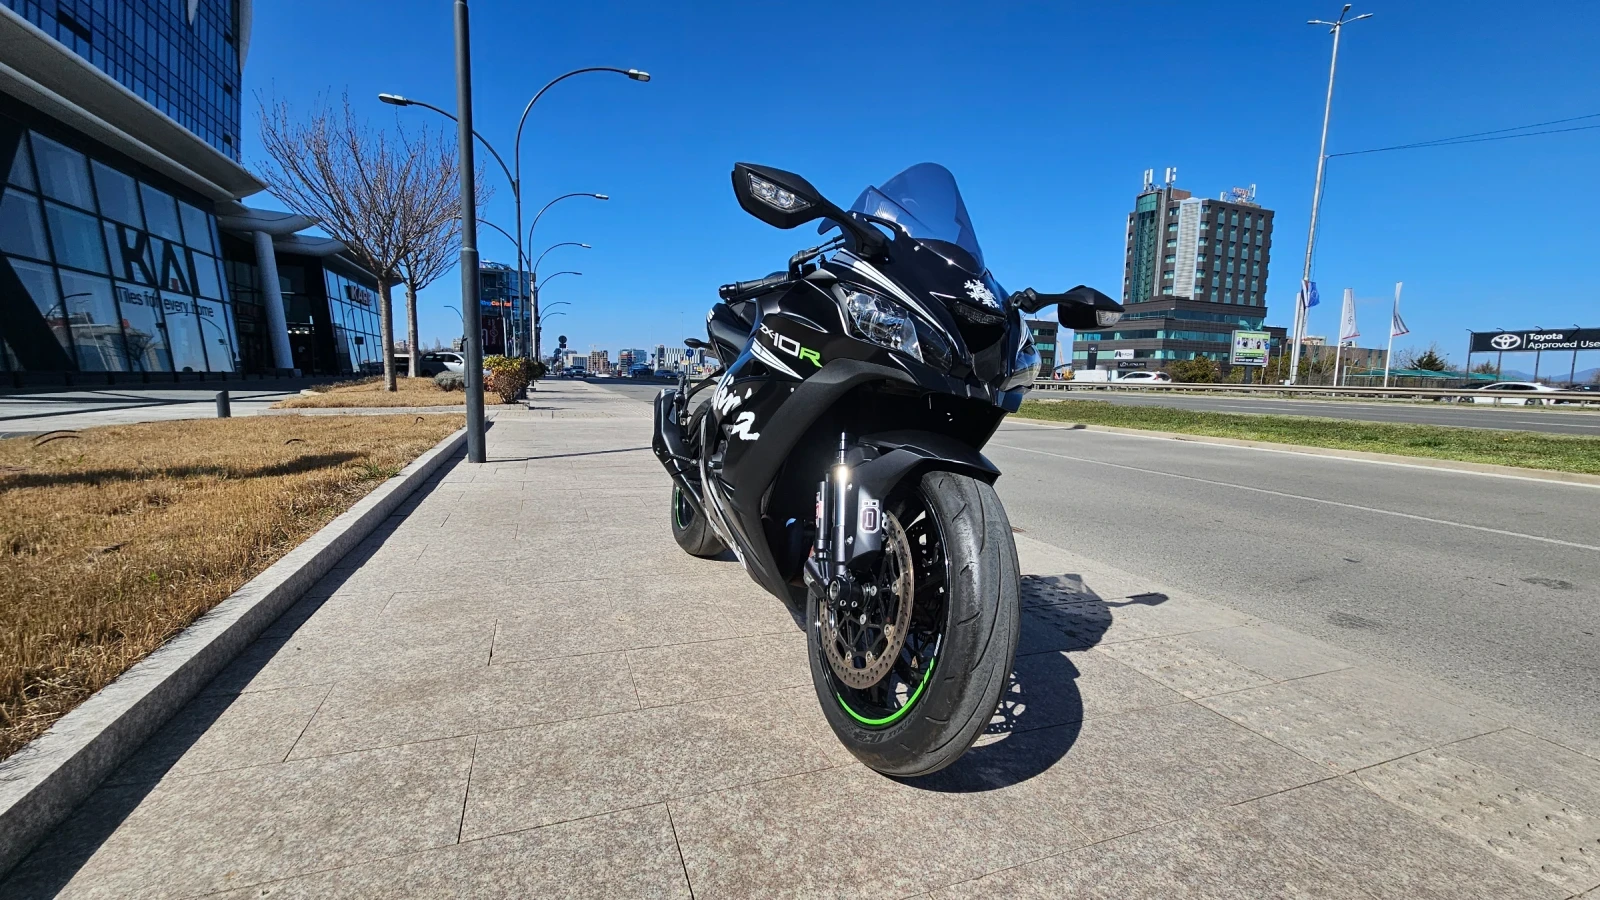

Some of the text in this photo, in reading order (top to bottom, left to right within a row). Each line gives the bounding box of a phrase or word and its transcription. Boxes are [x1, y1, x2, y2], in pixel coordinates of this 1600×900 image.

[115, 223, 200, 297] KAI
[115, 285, 143, 305] Tiles
[164, 298, 189, 317] every
[191, 301, 215, 318] home
[1527, 341, 1577, 349] Approved
[1529, 333, 1563, 341] Toyota
